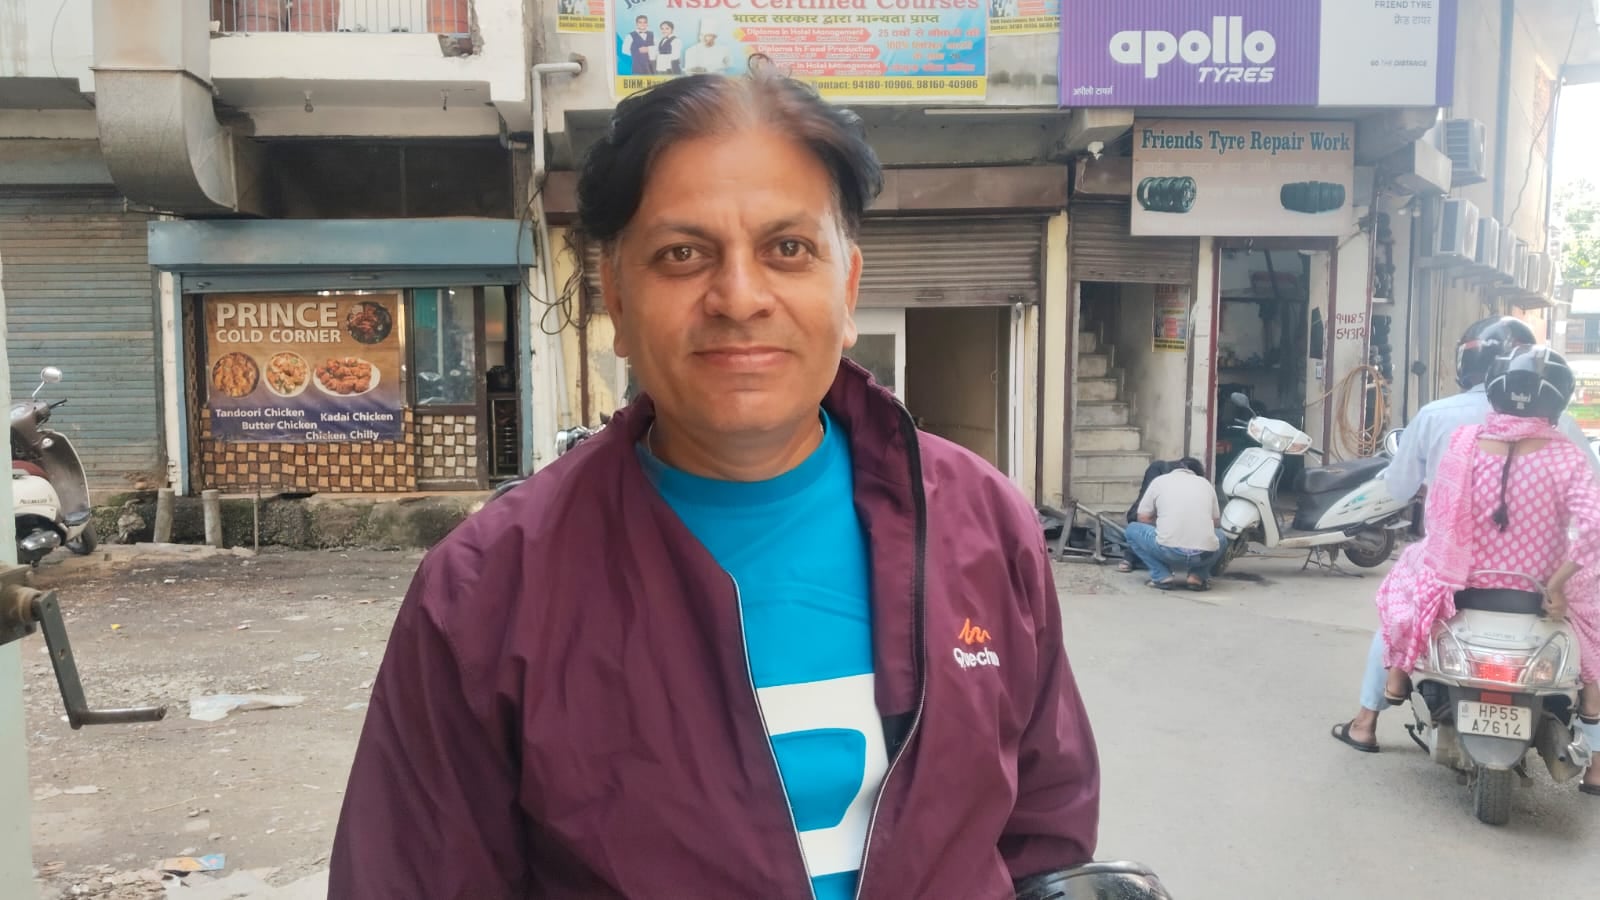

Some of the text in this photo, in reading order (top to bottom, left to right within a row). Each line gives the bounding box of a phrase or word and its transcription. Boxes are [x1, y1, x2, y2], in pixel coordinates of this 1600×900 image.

[666, 0, 741, 9] NSDC
[877, 0, 979, 9] Courses
[1374, 0, 1432, 8] FRIEND TYRE
[732, 14, 939, 25] भारत सरकार द्वारा मान्यता प्राप्त
[1109, 15, 1276, 78] apollo
[1199, 66, 1275, 83] TYRES
[1141, 128, 1350, 155] Friends Tyre Repair Work
[216, 302, 338, 328] PRINCE
[215, 329, 341, 343] COLD CORNER
[215, 408, 305, 417] Tandoori Chicken
[320, 412, 393, 422] Kadai Chicken
[242, 420, 318, 430] Butter Chicken
[305, 430, 379, 441] Chicken Chilly
[1479, 704, 1519, 721] HP55
[1472, 719, 1521, 737] A7614
